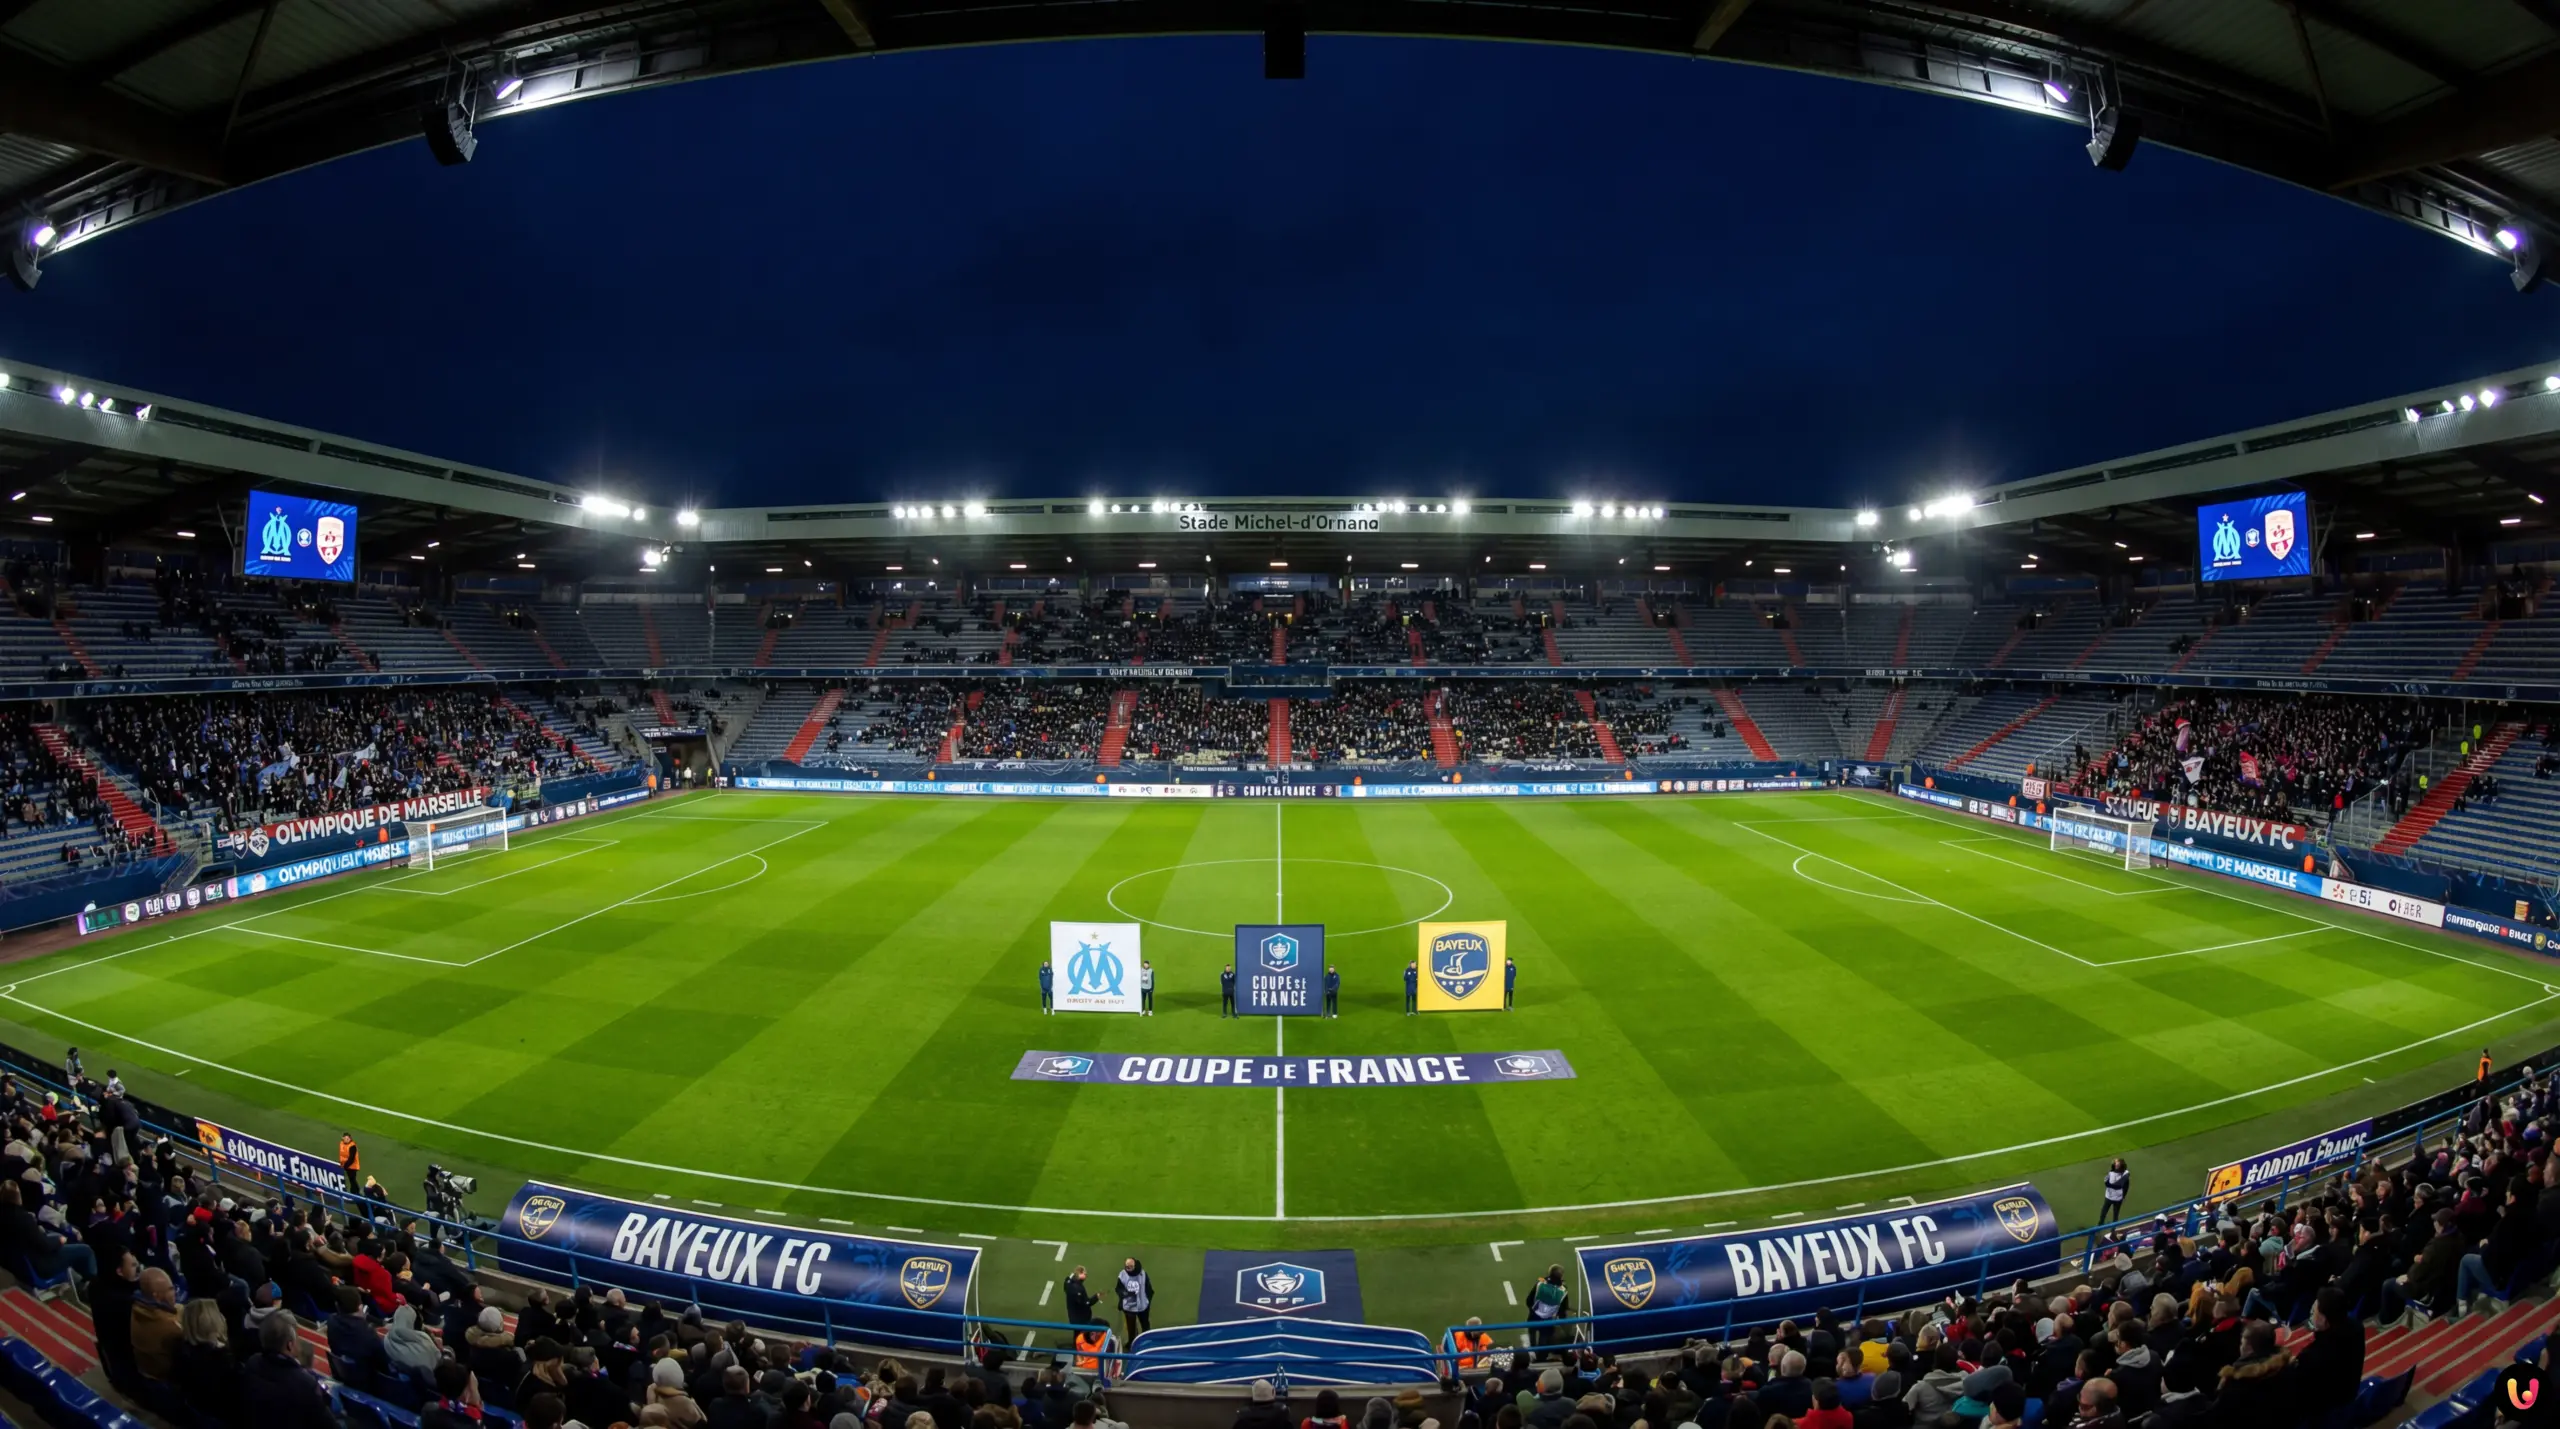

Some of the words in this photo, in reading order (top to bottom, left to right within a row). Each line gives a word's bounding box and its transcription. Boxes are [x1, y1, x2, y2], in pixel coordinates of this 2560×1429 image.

[1179, 514, 1229, 530] Stade
[275, 808, 375, 846] OLYMPIQUE
[379, 803, 400, 825] DE
[404, 789, 482, 821] MARSEILLE
[2184, 808, 2266, 845] BAYEUX
[2269, 823, 2296, 850] FC
[2217, 853, 2233, 871] DE
[1435, 939, 1484, 952] BAYEUX
[1252, 975, 1292, 990] COUPE
[1252, 990, 1307, 1007] FRANCE
[1118, 1056, 1254, 1084] COUPE
[1263, 1062, 1297, 1080] DE
[1307, 1056, 1470, 1084] FRANCE
[611, 1212, 774, 1288] BAYEUX
[771, 1237, 831, 1296] FC
[1724, 1223, 1884, 1297] BAYEUX
[1889, 1214, 1946, 1270] FC
